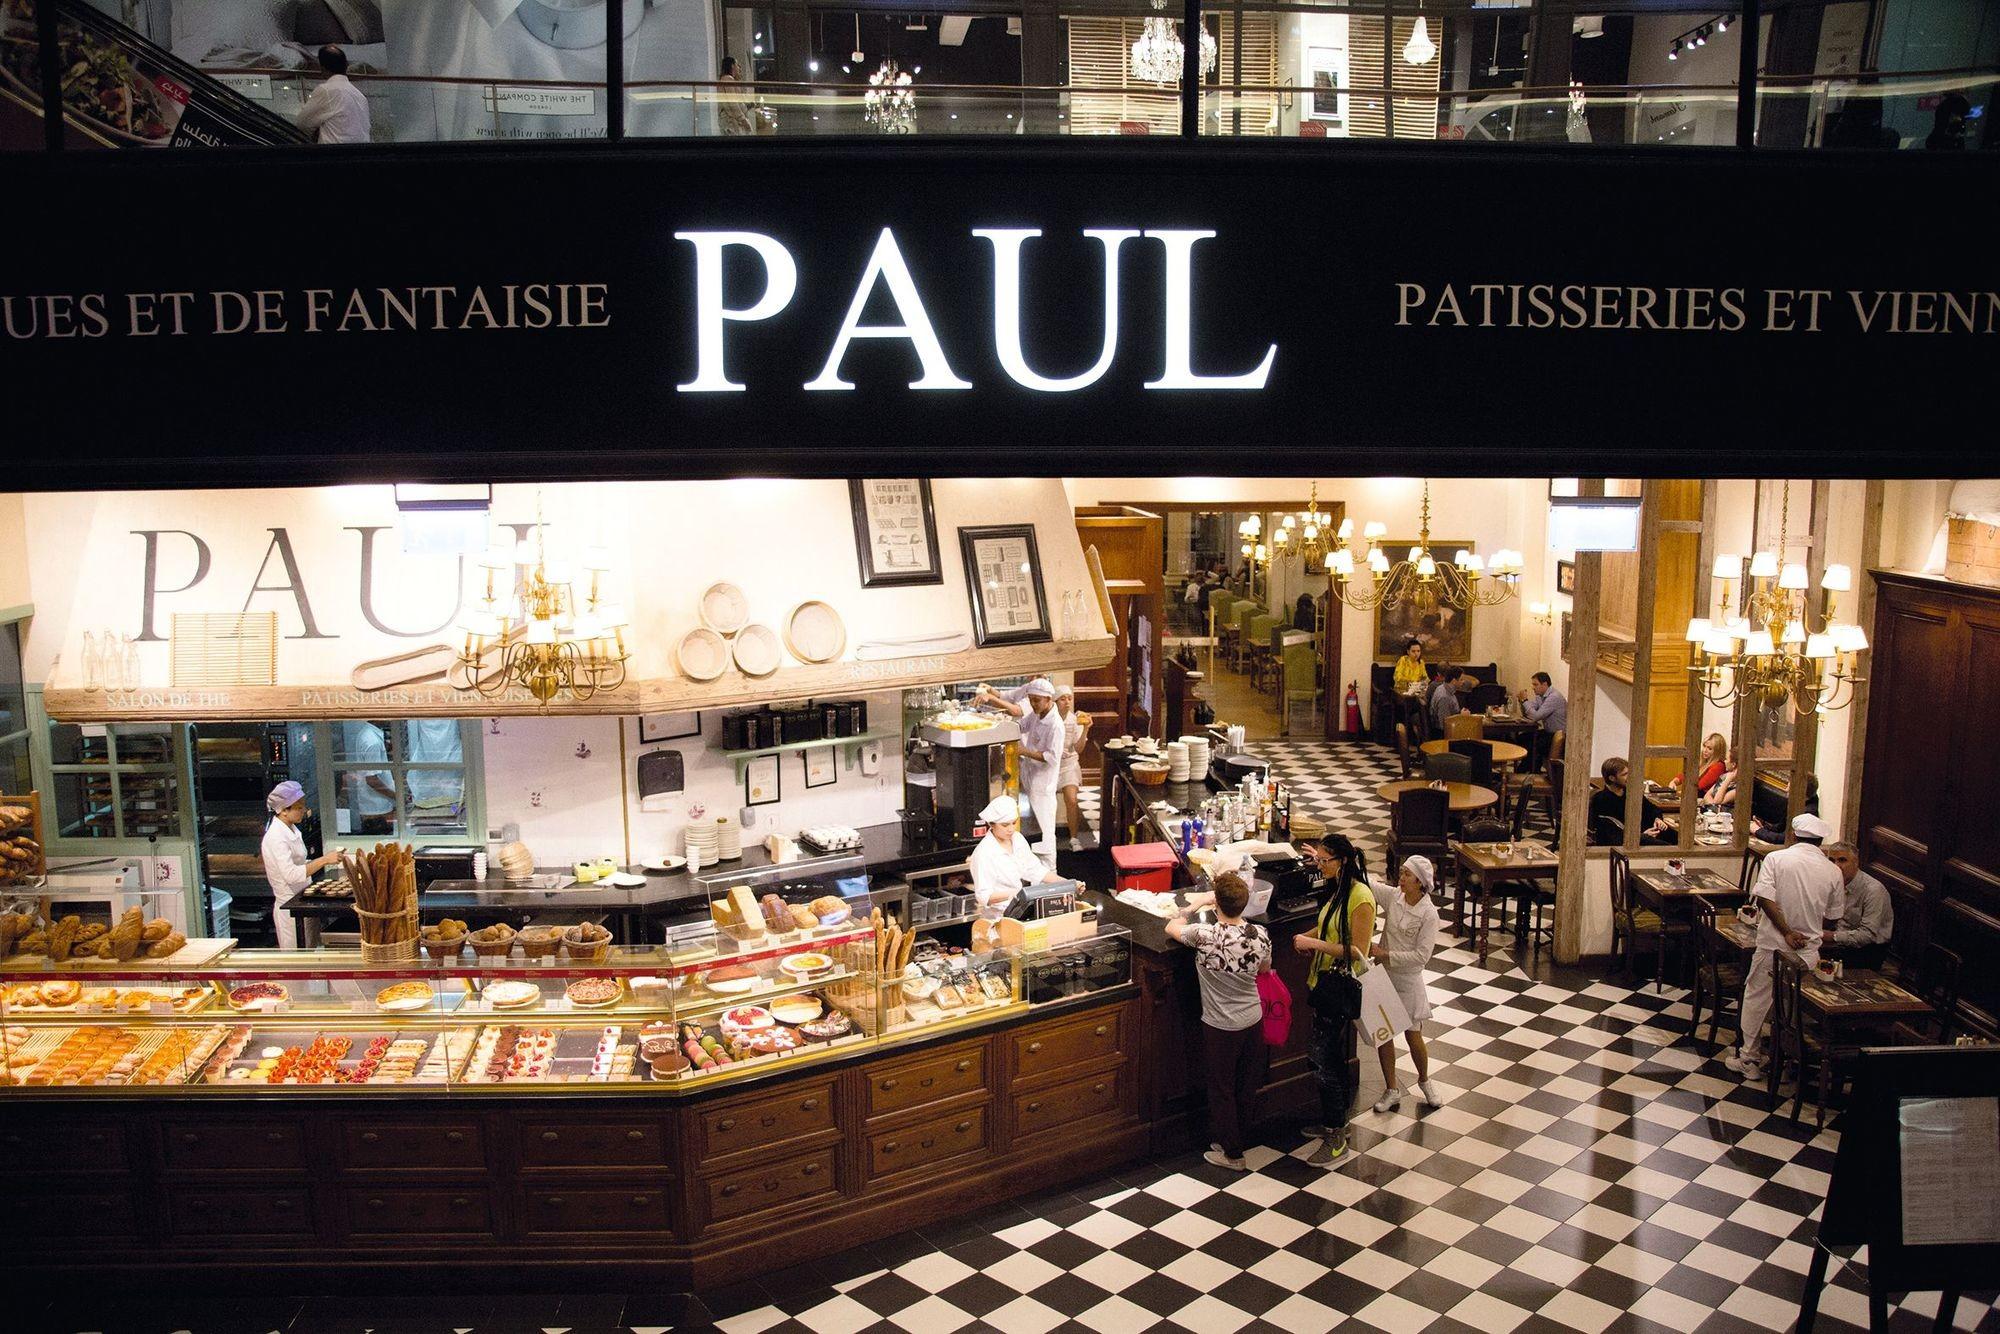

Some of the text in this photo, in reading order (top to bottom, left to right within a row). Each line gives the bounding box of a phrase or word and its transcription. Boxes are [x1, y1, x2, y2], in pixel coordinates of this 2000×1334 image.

[1, 283, 612, 339] UES ET DE FANTAISIE
[674, 227, 1278, 392] PAUL
[1394, 283, 1746, 331] PATISSERIES
[1762, 289, 1832, 332] ET
[850, 654, 945, 678] RESTAURANT
[107, 692, 164, 707] SALON
[168, 693, 192, 706] DE
[302, 690, 409, 705] PATISSERIES
[413, 690, 433, 704] ET
